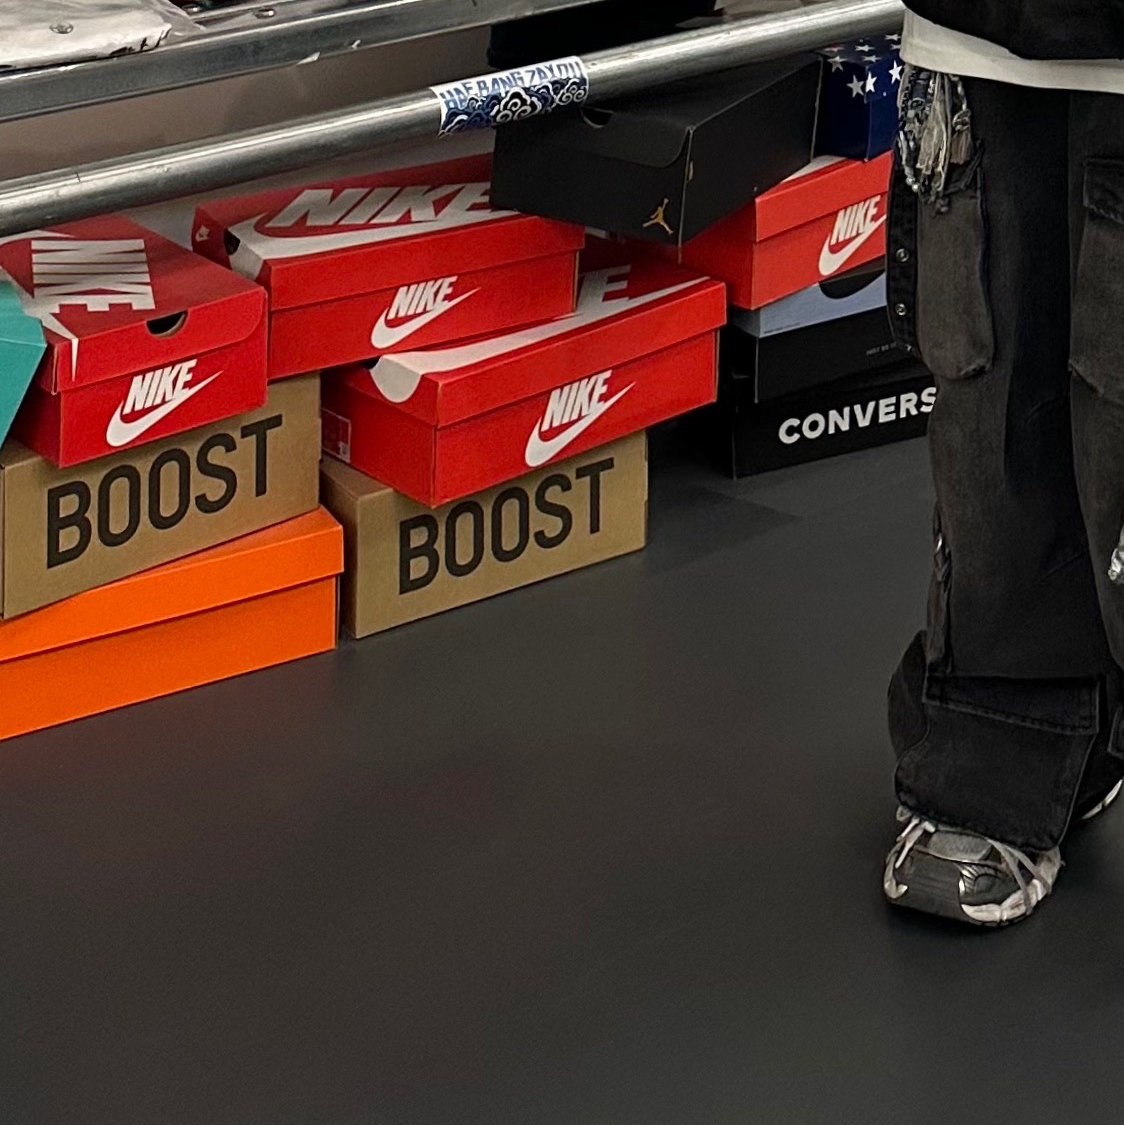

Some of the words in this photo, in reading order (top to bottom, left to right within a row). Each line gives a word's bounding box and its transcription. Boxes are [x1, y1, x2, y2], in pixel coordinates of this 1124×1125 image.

[265, 182, 492, 227] NIKE
[830, 195, 881, 246] NIKE
[388, 276, 459, 321] NIKE
[123, 358, 197, 415] NIKE
[540, 369, 612, 432] NIKE
[778, 386, 937, 445] CONVERS
[46, 413, 283, 570] BOOST
[399, 457, 615, 595] BOOST
